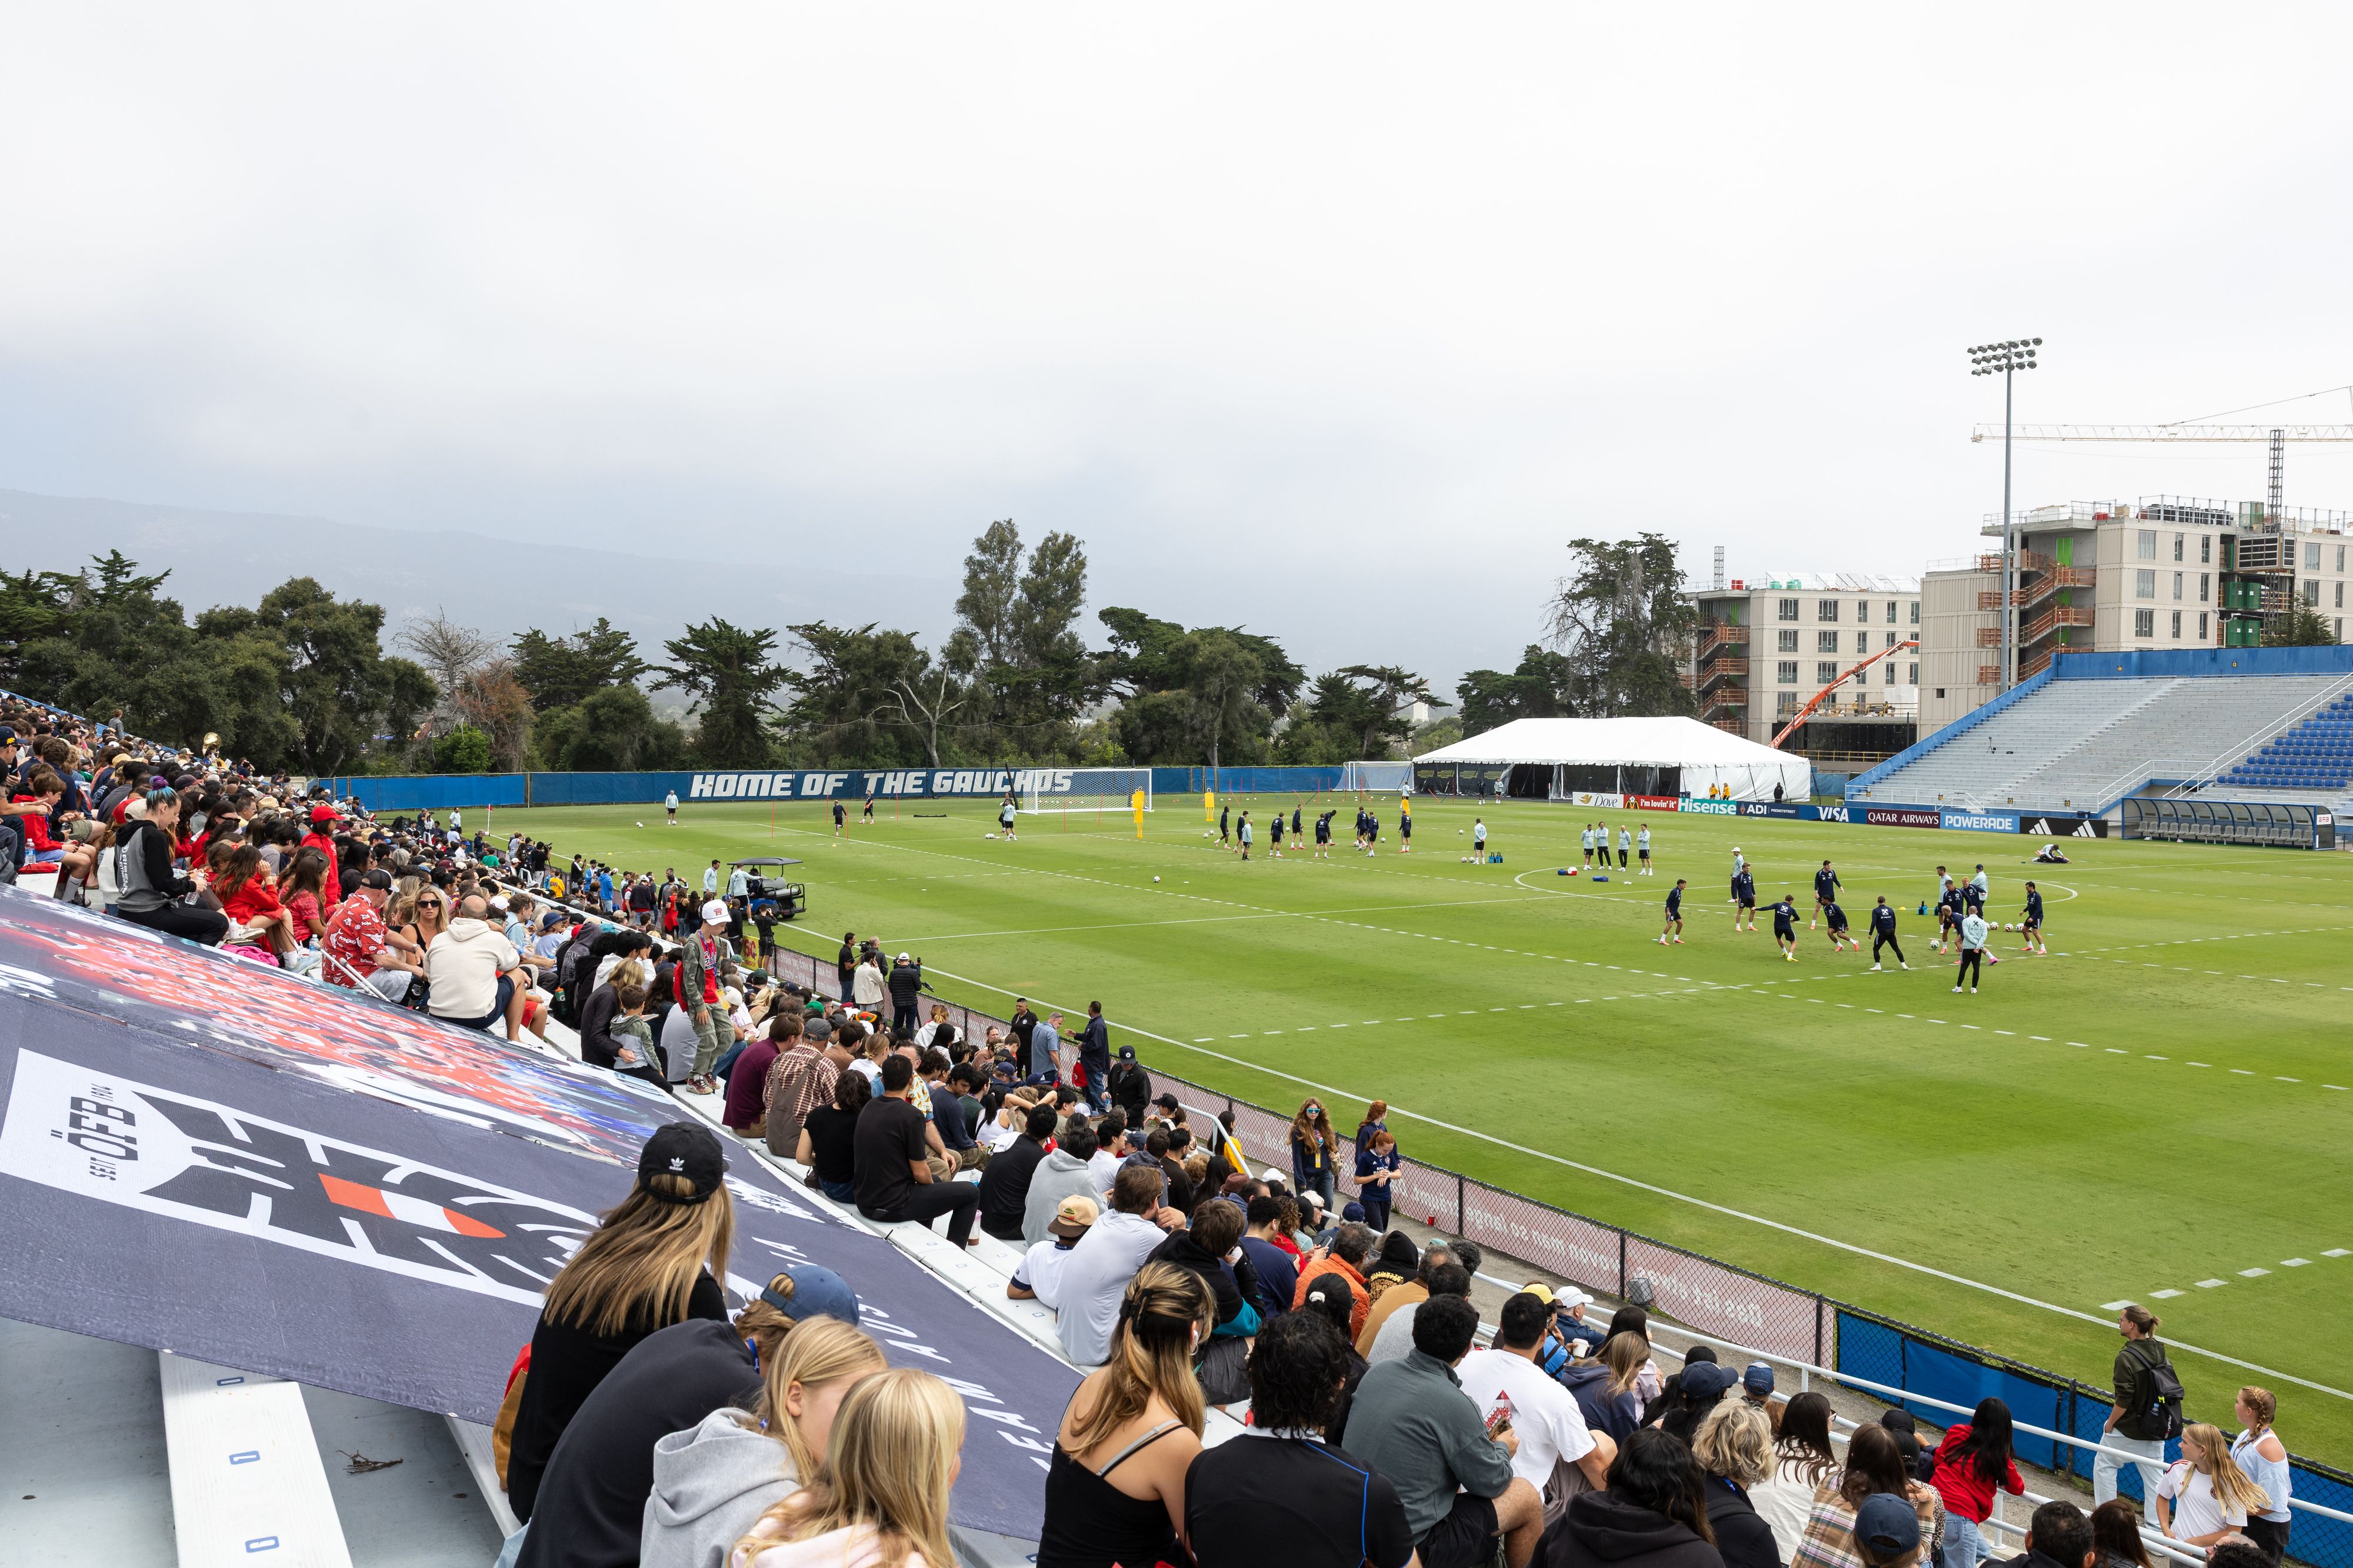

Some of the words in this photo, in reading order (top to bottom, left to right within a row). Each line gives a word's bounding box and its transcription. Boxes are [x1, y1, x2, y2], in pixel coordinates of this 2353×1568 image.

[689, 773, 795, 798] HOME
[801, 773, 848, 796] OF
[864, 771, 926, 795] THE
[932, 771, 1074, 793] GAUCHOS
[1594, 793, 1618, 808] Dove
[1651, 799, 1668, 808] lovin'
[1678, 798, 1737, 815] Hisense
[1747, 804, 1767, 815] ADI
[1817, 806, 1849, 822] VISA
[1868, 812, 1898, 823] QATAR
[1901, 814, 1939, 825] AIRWAYS
[1945, 815, 2012, 830] POWERADE
[90, 1083, 114, 1102] 1904
[51, 1096, 138, 1161] ÖFB
[89, 1156, 116, 1181] SEIT
[751, 1236, 952, 1364] AUSIA
